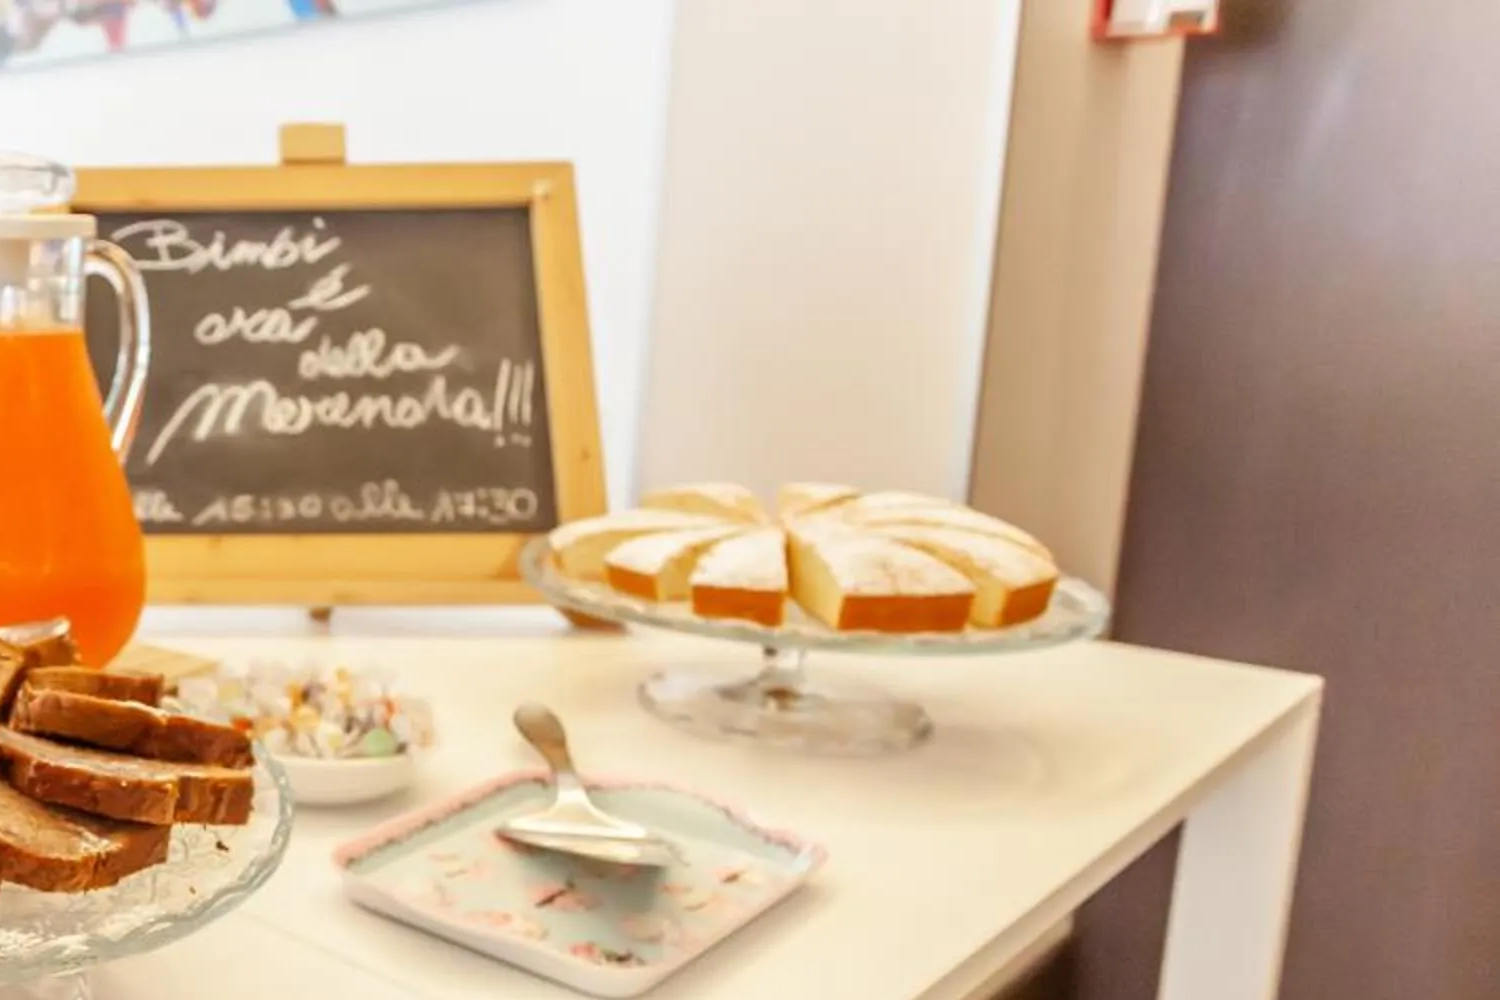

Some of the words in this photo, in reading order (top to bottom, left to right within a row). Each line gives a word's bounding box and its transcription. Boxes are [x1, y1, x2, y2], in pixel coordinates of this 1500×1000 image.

[111, 217, 341, 274] Bimbi
[194, 306, 318, 345] ora
[299, 327, 461, 380] della
[329, 478, 424, 522] alle
[430, 486, 538, 525] 17:30
